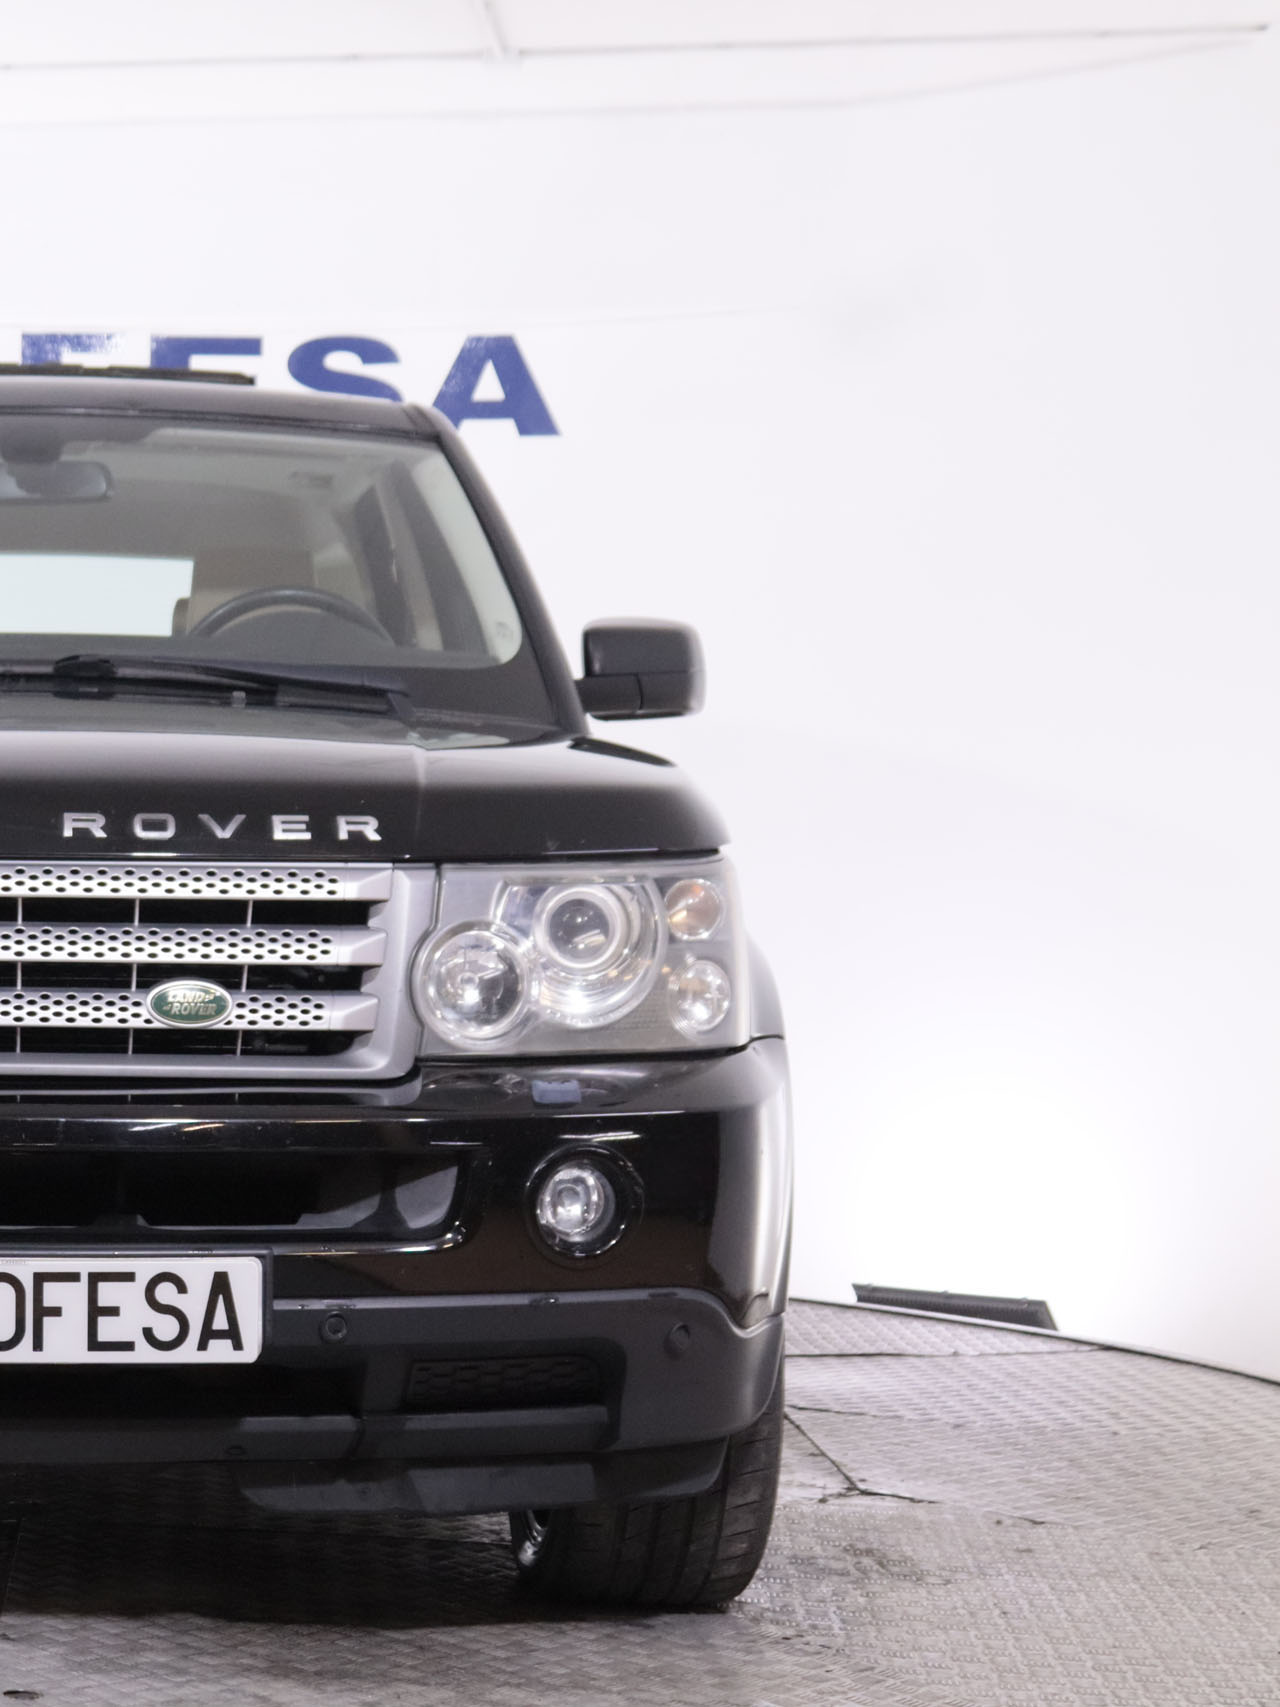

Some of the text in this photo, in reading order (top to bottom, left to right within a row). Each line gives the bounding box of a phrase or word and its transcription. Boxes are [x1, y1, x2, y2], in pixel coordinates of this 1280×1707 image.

[62, 812, 383, 841] ROVER
[167, 989, 206, 1003] LAND
[170, 1003, 218, 1016] ROVER
